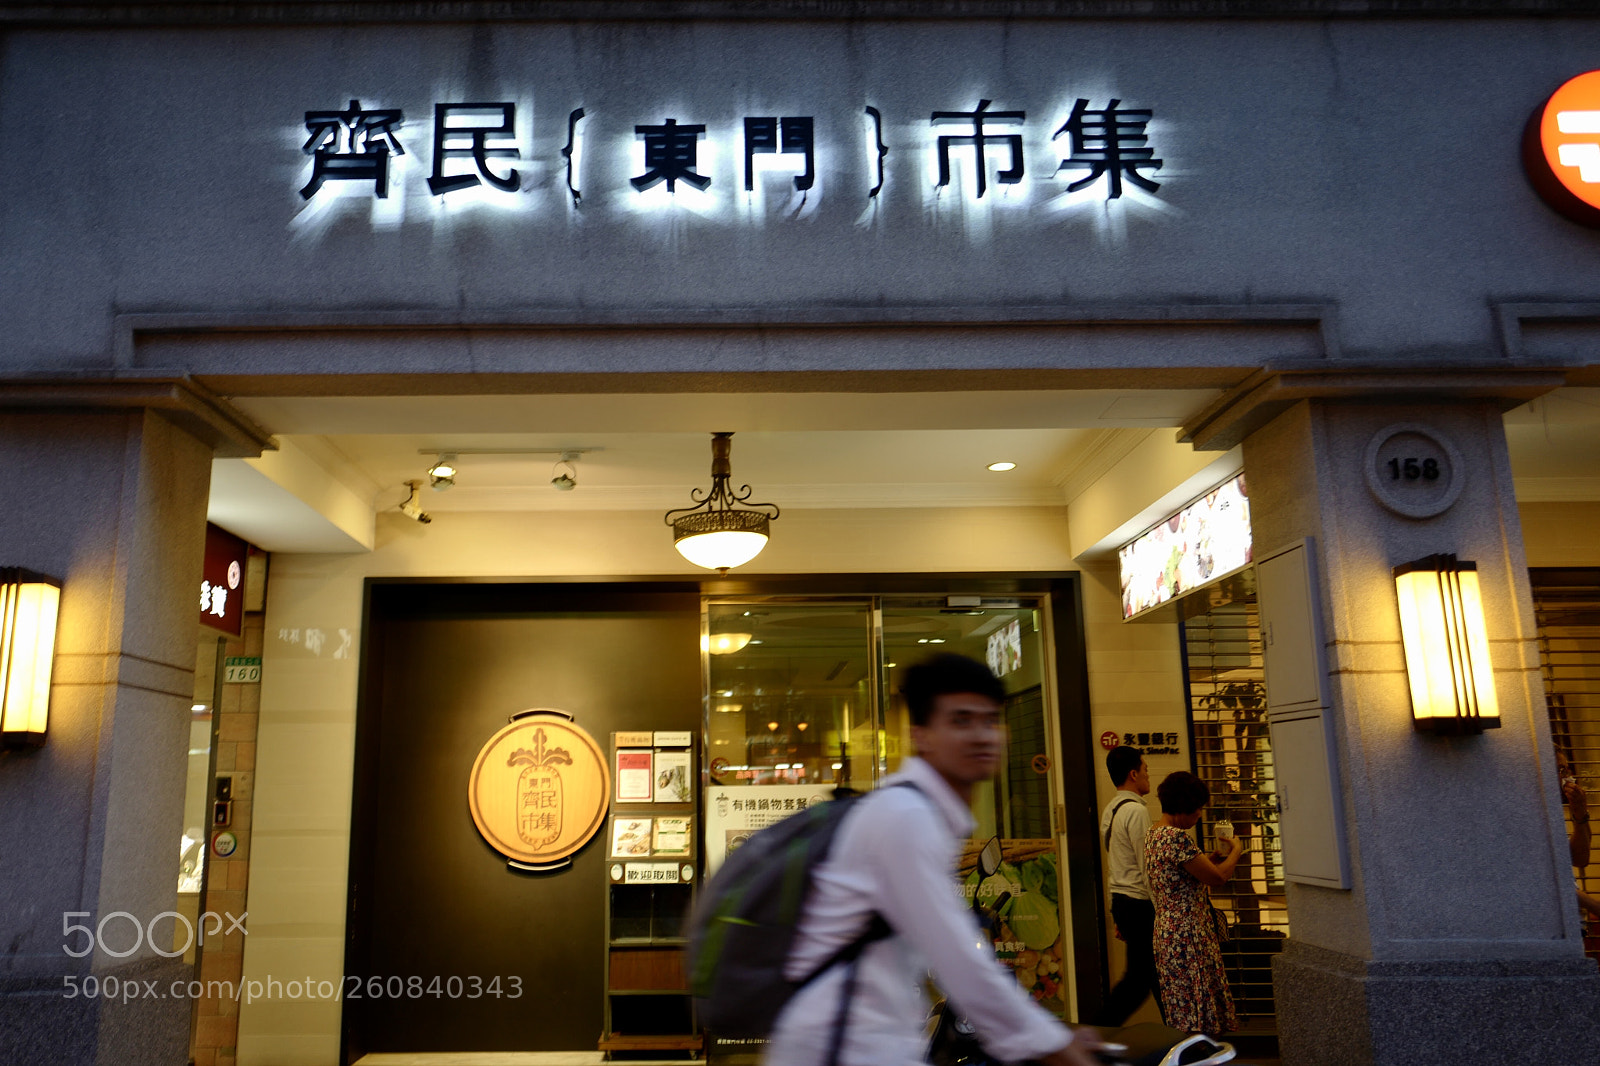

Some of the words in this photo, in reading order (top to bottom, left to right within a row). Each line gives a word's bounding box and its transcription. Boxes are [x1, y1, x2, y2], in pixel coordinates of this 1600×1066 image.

[1388, 457, 1440, 480] 158
[228, 668, 258, 680] 160
[1146, 747, 1180, 755] SinoPac
[529, 778, 551, 789] 東門
[522, 790, 557, 810] 齊民
[732, 798, 807, 811] 有機鍋物套餐
[521, 812, 557, 832] 市集
